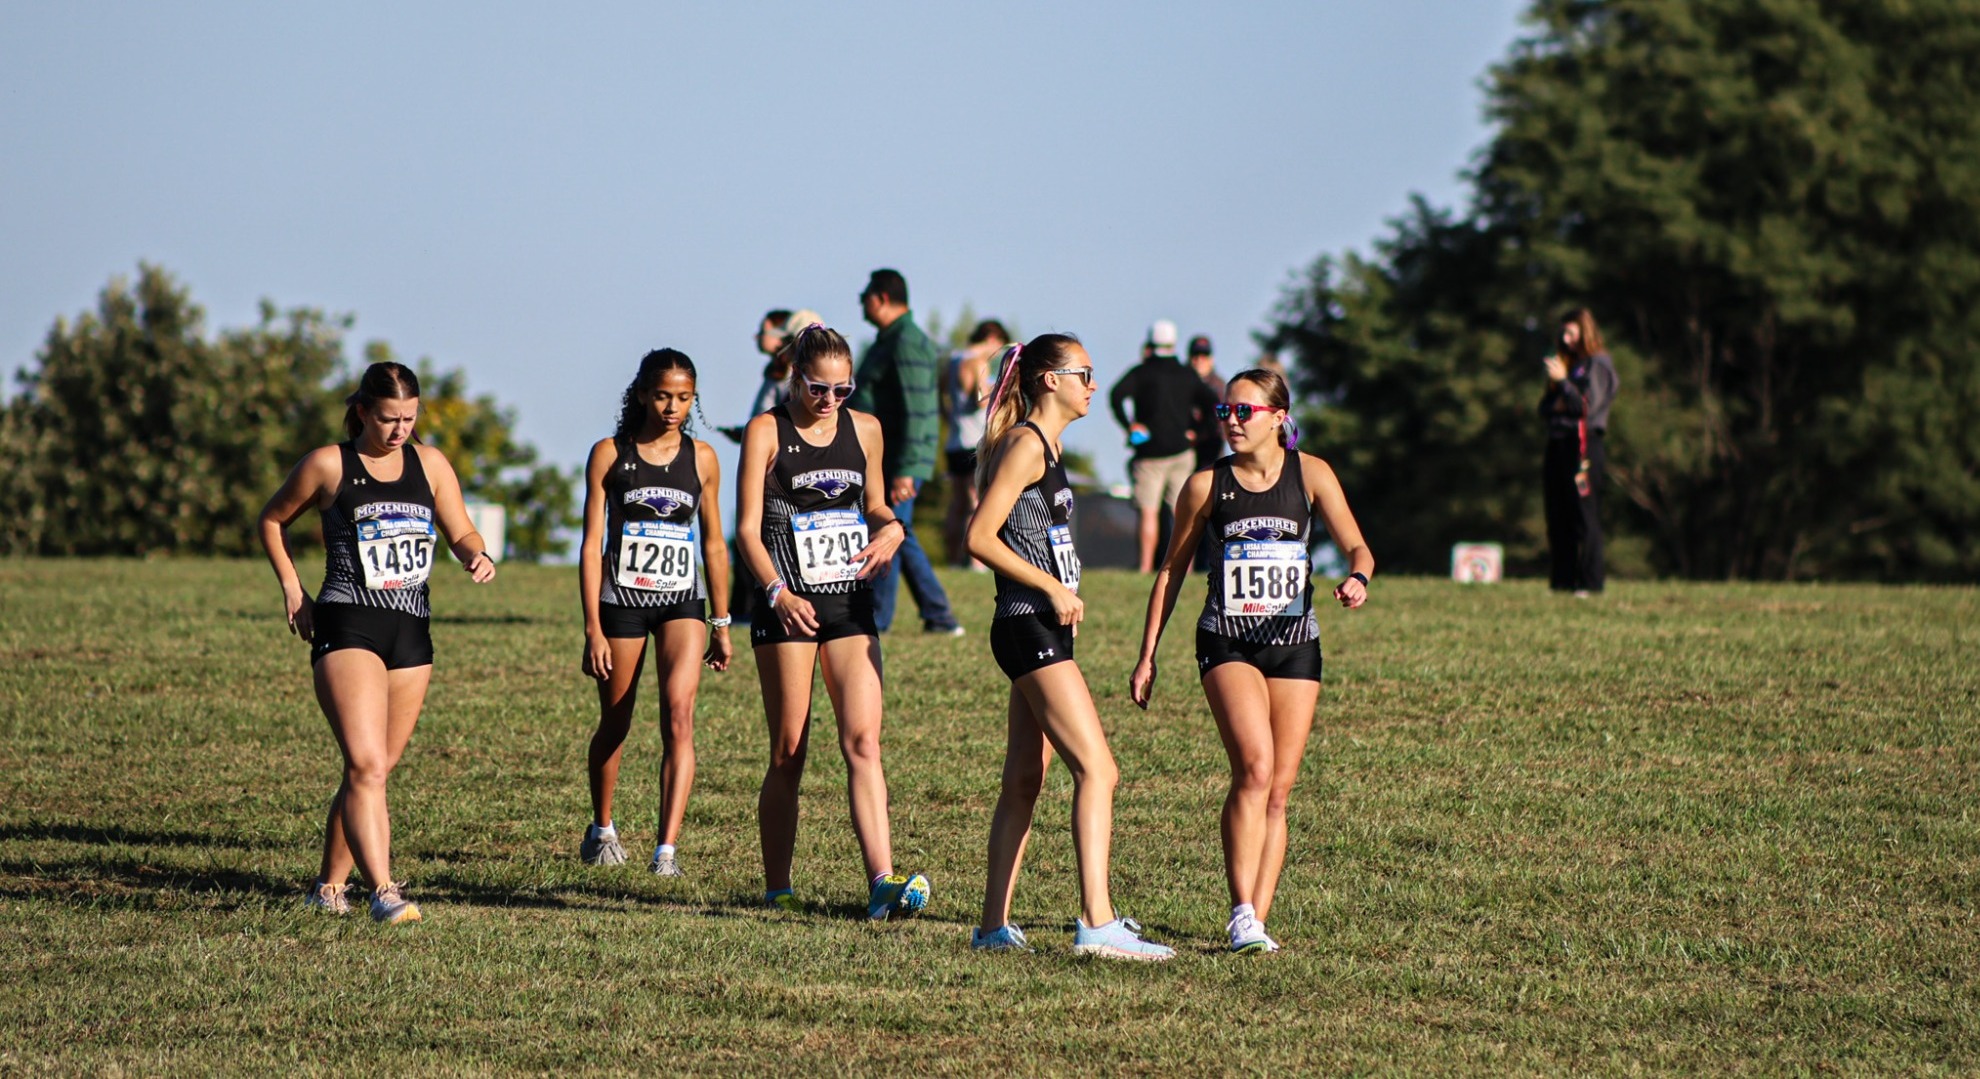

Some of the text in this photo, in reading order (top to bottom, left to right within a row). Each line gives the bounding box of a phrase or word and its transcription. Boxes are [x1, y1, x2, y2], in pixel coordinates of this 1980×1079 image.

[367, 538, 430, 577] 1435
[626, 542, 689, 577] 1289
[803, 531, 864, 568] 1293
[1060, 549, 1081, 584] 143
[383, 574, 419, 590] MileSplit
[633, 576, 677, 591] MileSplit
[1231, 565, 1300, 600] 1588
[1242, 603, 1288, 615] MileSplit
